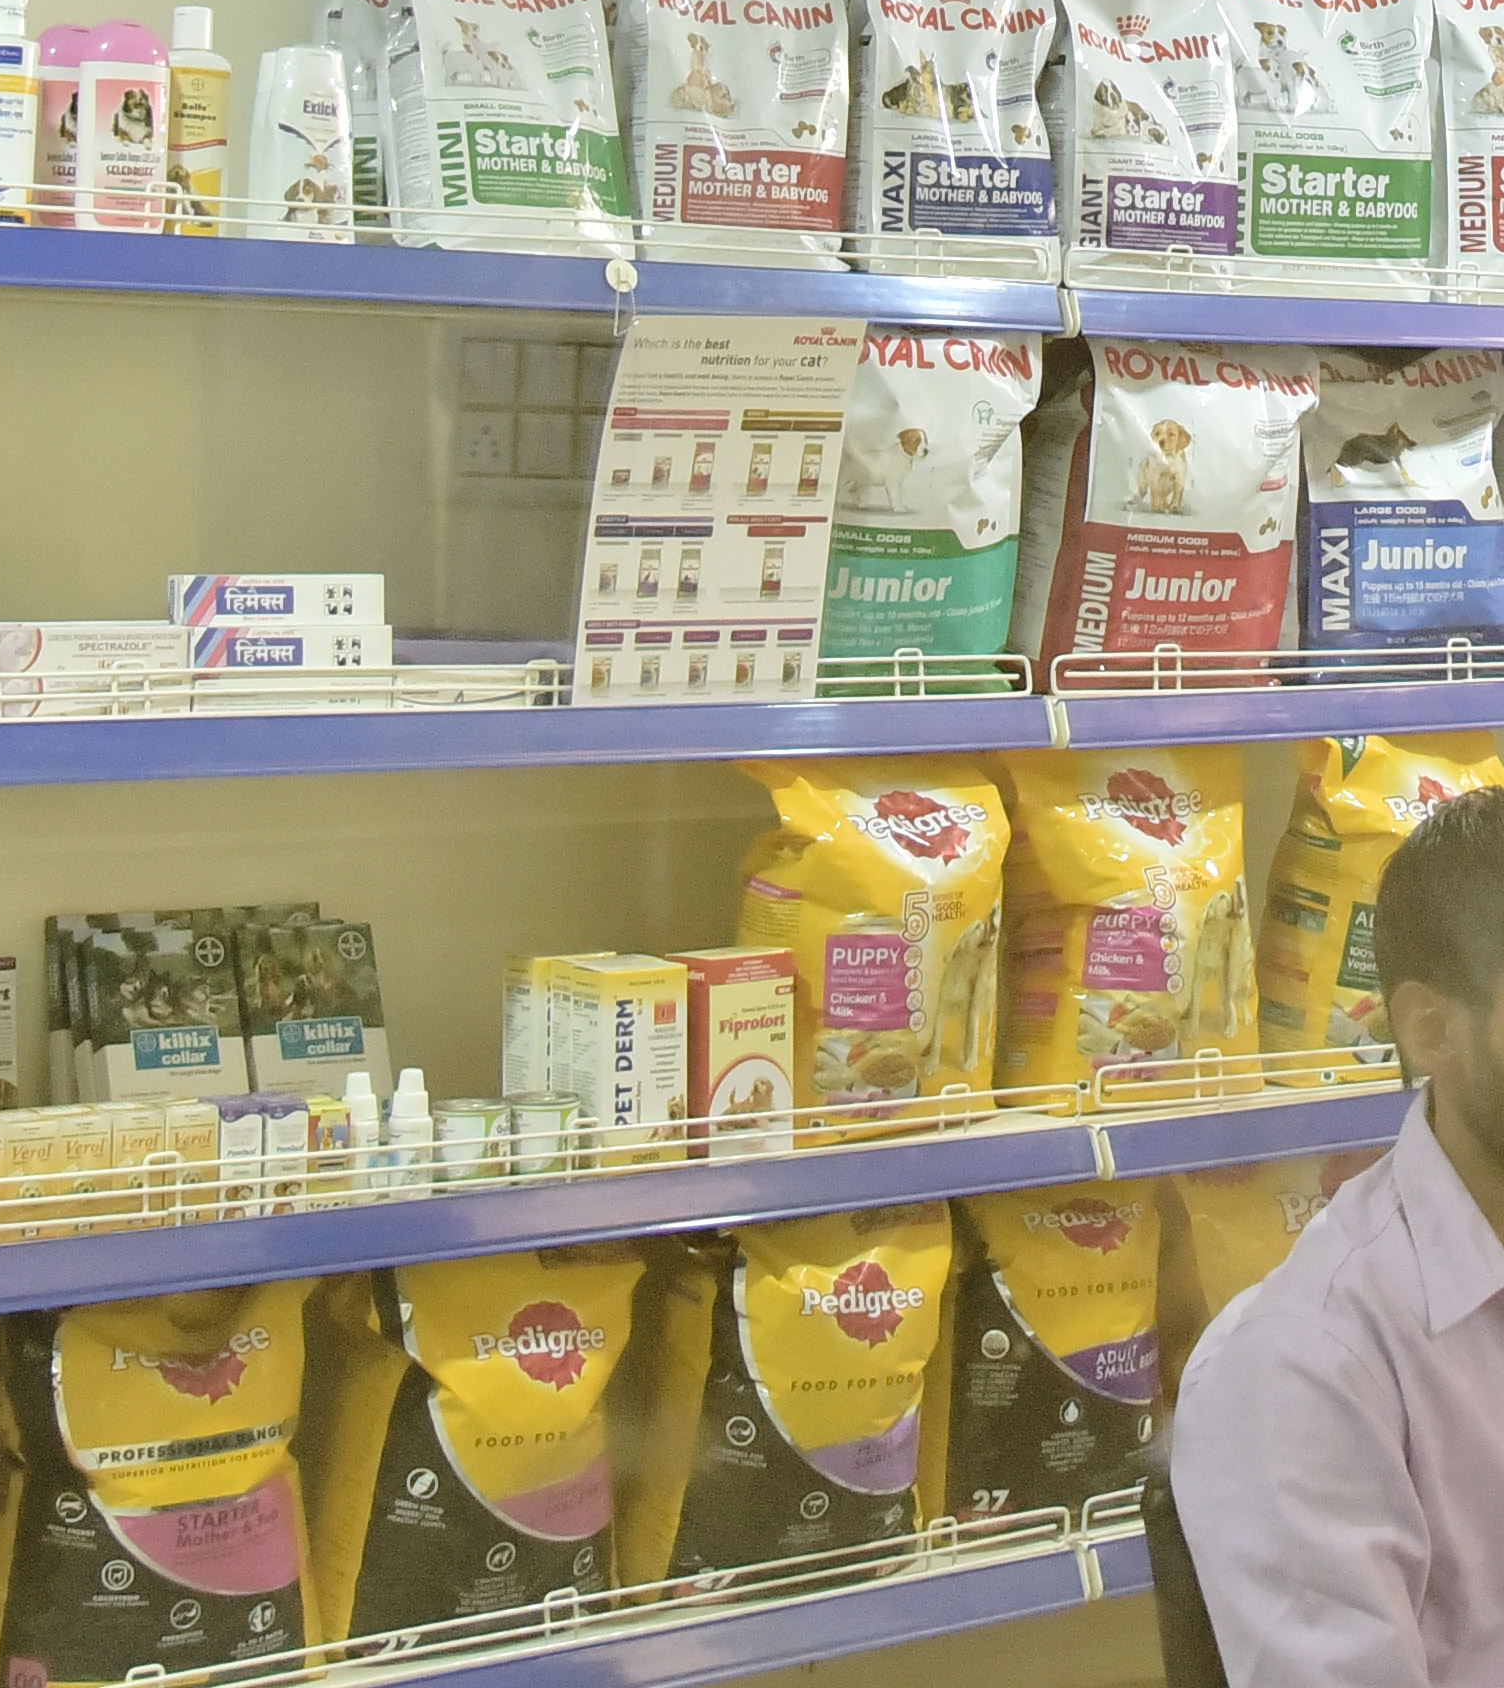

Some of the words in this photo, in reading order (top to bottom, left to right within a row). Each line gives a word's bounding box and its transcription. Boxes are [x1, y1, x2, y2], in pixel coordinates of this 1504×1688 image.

[744, 0, 833, 30] CANIN
[961, 8, 1045, 34] CANIN
[1359, 40, 1385, 50] Birth
[474, 129, 580, 160] Starter
[1254, 131, 1292, 140] SMALL
[1296, 133, 1324, 141] DOGS
[437, 121, 468, 207] MINI
[477, 157, 537, 173] MOTHER
[541, 160, 552, 173] &
[555, 160, 607, 182] BABYDOG
[690, 153, 801, 184] Starter
[916, 161, 1019, 187] Starter
[1261, 163, 1389, 198] Starter
[688, 181, 752, 197] MOTHER
[756, 185, 766, 198] &
[771, 185, 829, 203] BABYDOG
[881, 151, 905, 232] MAXI
[916, 187, 974, 202] MOTHER
[979, 191, 988, 203] &
[992, 191, 1042, 204] BABYDOG
[1113, 183, 1204, 212] Starter
[1080, 174, 1103, 247] GIANT
[1261, 198, 1333, 216] MOTHER
[1338, 203, 1351, 218] &
[1355, 202, 1418, 218] BABYDOG
[1458, 156, 1486, 253] MEDIUM
[1113, 209, 1165, 224] MOTHER
[1168, 213, 1176, 224] &
[1180, 213, 1225, 228] BABYDOG
[634, 338, 667, 349] Which
[671, 339, 680, 349] is
[684, 339, 701, 349] the
[705, 340, 730, 349] best
[794, 336, 824, 345] ROYAL
[827, 337, 857, 346] CANIN
[701, 355, 751, 366] nutrition
[754, 356, 767, 366] for
[772, 358, 796, 368] your
[800, 355, 828, 367] cat?
[1105, 347, 1210, 386] ROYAL
[876, 534, 911, 543] DOGS
[1127, 534, 1174, 544] MEDIUM
[1177, 536, 1208, 545] DOGS
[1362, 539, 1467, 570] Junior
[828, 568, 951, 601] Junior
[1126, 569, 1237, 602] Junior
[1322, 528, 1350, 630] MAXI
[1362, 581, 1393, 592] Puppies
[1396, 582, 1404, 591] up
[1406, 581, 1413, 589] to
[1074, 551, 1117, 654] MEDIUM
[1122, 612, 1154, 623] Puppies
[78, 642, 148, 650] SPECTRAZOLE
[1078, 789, 1201, 822] Pedigree
[935, 901, 962, 911] GOOD
[932, 911, 966, 922] HEALTH
[1093, 914, 1158, 930] PUPPY
[832, 947, 901, 965] PUPPY
[1089, 952, 1132, 964] Chicken
[1088, 965, 1111, 976] Milk
[830, 993, 876, 1004] Chicken
[830, 1007, 854, 1017] Milk
[303, 1023, 356, 1041] kiltix
[615, 998, 634, 1072] DERM
[719, 1012, 786, 1039] Fiprofort
[158, 1031, 211, 1049] kiltix
[306, 1040, 351, 1056] collar
[161, 1049, 207, 1065] collar
[615, 1083, 633, 1127] PET
[632, 1151, 660, 1163] zoetis
[1037, 1286, 1078, 1298] FOOD
[1088, 1281, 1114, 1293] FOR
[800, 1286, 924, 1317] Pedigree
[471, 1328, 605, 1360] Pedigree
[1097, 1346, 1137, 1365] ADULT
[1096, 1361, 1135, 1381] SMALL
[791, 1381, 838, 1391] FOOD
[848, 1379, 877, 1390] FOR
[475, 1436, 524, 1448] FOOD
[535, 1431, 567, 1444] FOR
[112, 1467, 164, 1479] SUPERIOR
[169, 1458, 226, 1473] NUTRITION
[231, 1452, 248, 1462] FOR
[971, 1489, 1009, 1512] 27
